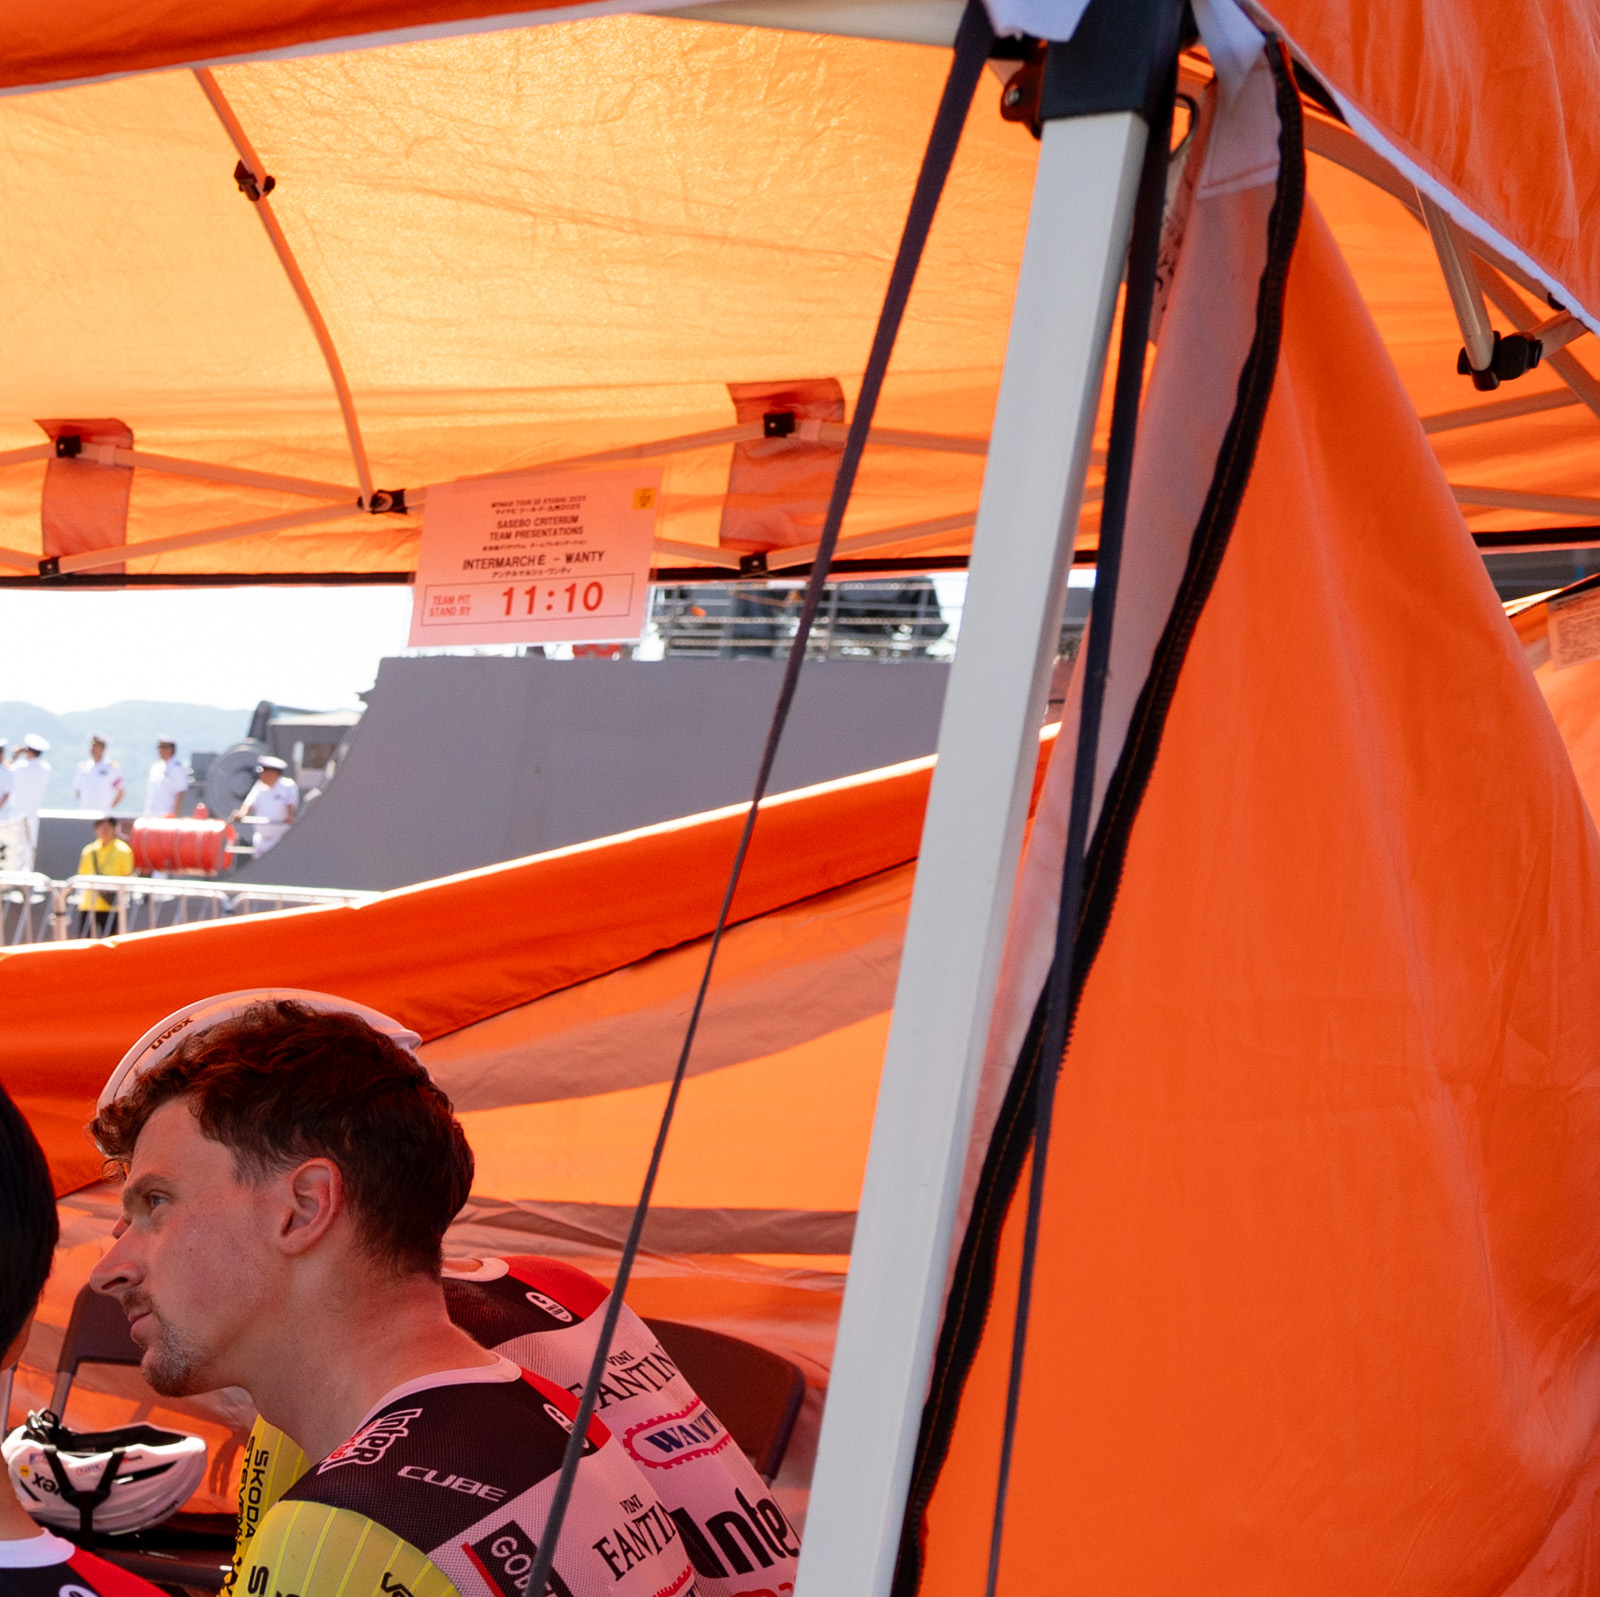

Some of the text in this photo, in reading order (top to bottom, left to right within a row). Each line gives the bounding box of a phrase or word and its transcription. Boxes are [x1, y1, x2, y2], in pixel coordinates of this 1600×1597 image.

[497, 515, 580, 529] SASEBO CRITERIUM
[489, 526, 584, 541] TEAM PRESENTATIONS
[565, 550, 606, 564] WANTY
[432, 595, 457, 606] TEAM
[503, 581, 604, 616] 11:10
[429, 606, 471, 617] STAND BY
[606, 1350, 636, 1368] VINI
[396, 1465, 507, 1503] CUBE
[246, 1449, 268, 1539] SKODA
[619, 1494, 644, 1515] VINI
